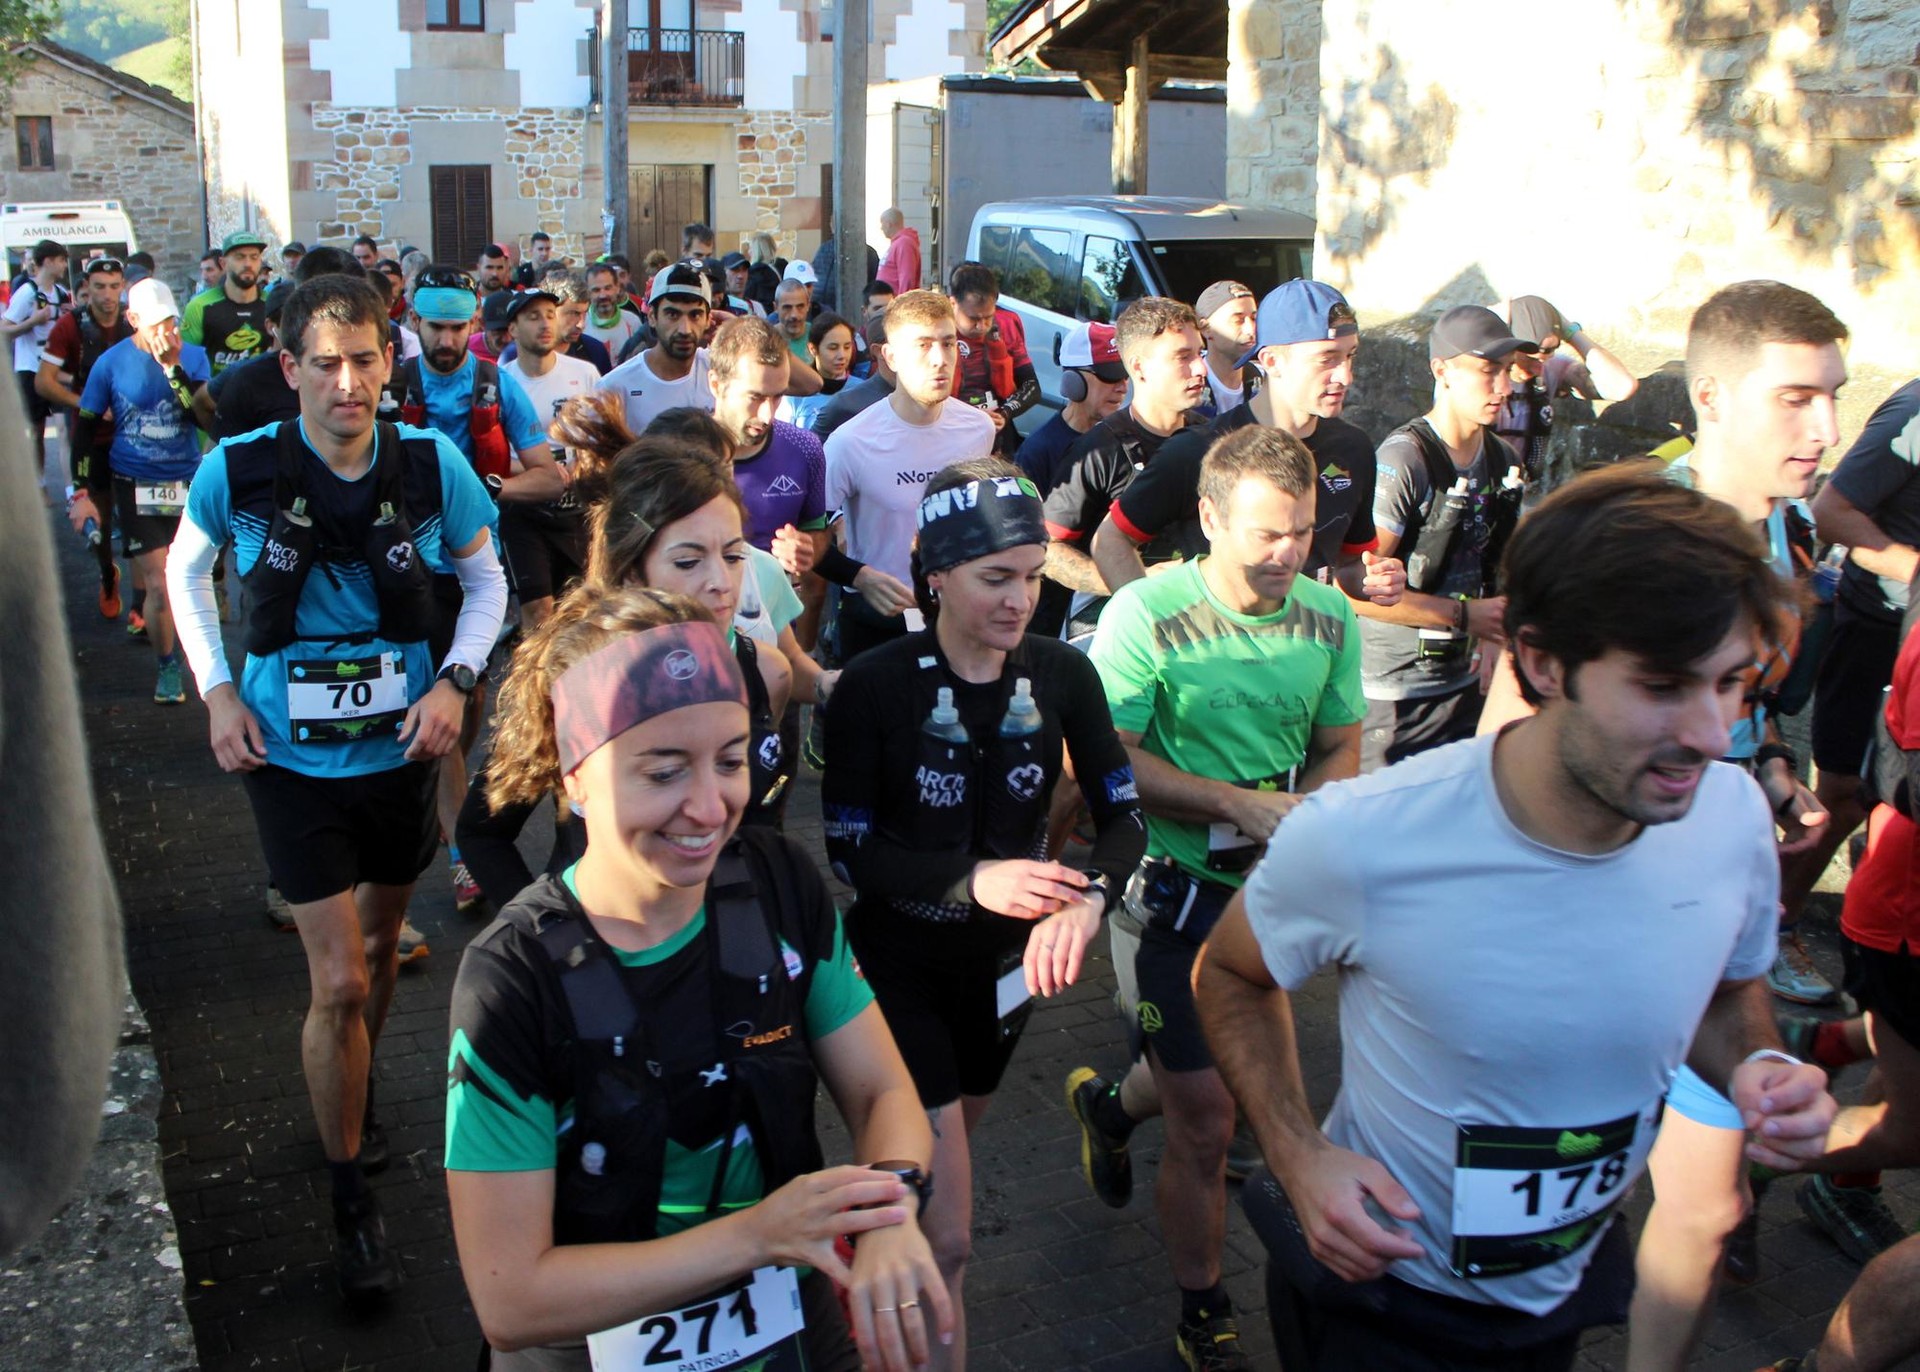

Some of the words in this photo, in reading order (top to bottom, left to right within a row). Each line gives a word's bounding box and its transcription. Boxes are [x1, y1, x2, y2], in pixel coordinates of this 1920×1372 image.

[22, 225, 107, 237] AMBULANCIA
[148, 488, 177, 501] 140
[266, 553, 299, 572] MAX
[326, 681, 372, 709] 70
[341, 709, 360, 717] IKER
[919, 787, 965, 807] MAX
[1512, 1152, 1629, 1216] 178
[639, 1287, 758, 1367] 271
[677, 1348, 741, 1372] PATRICIA
